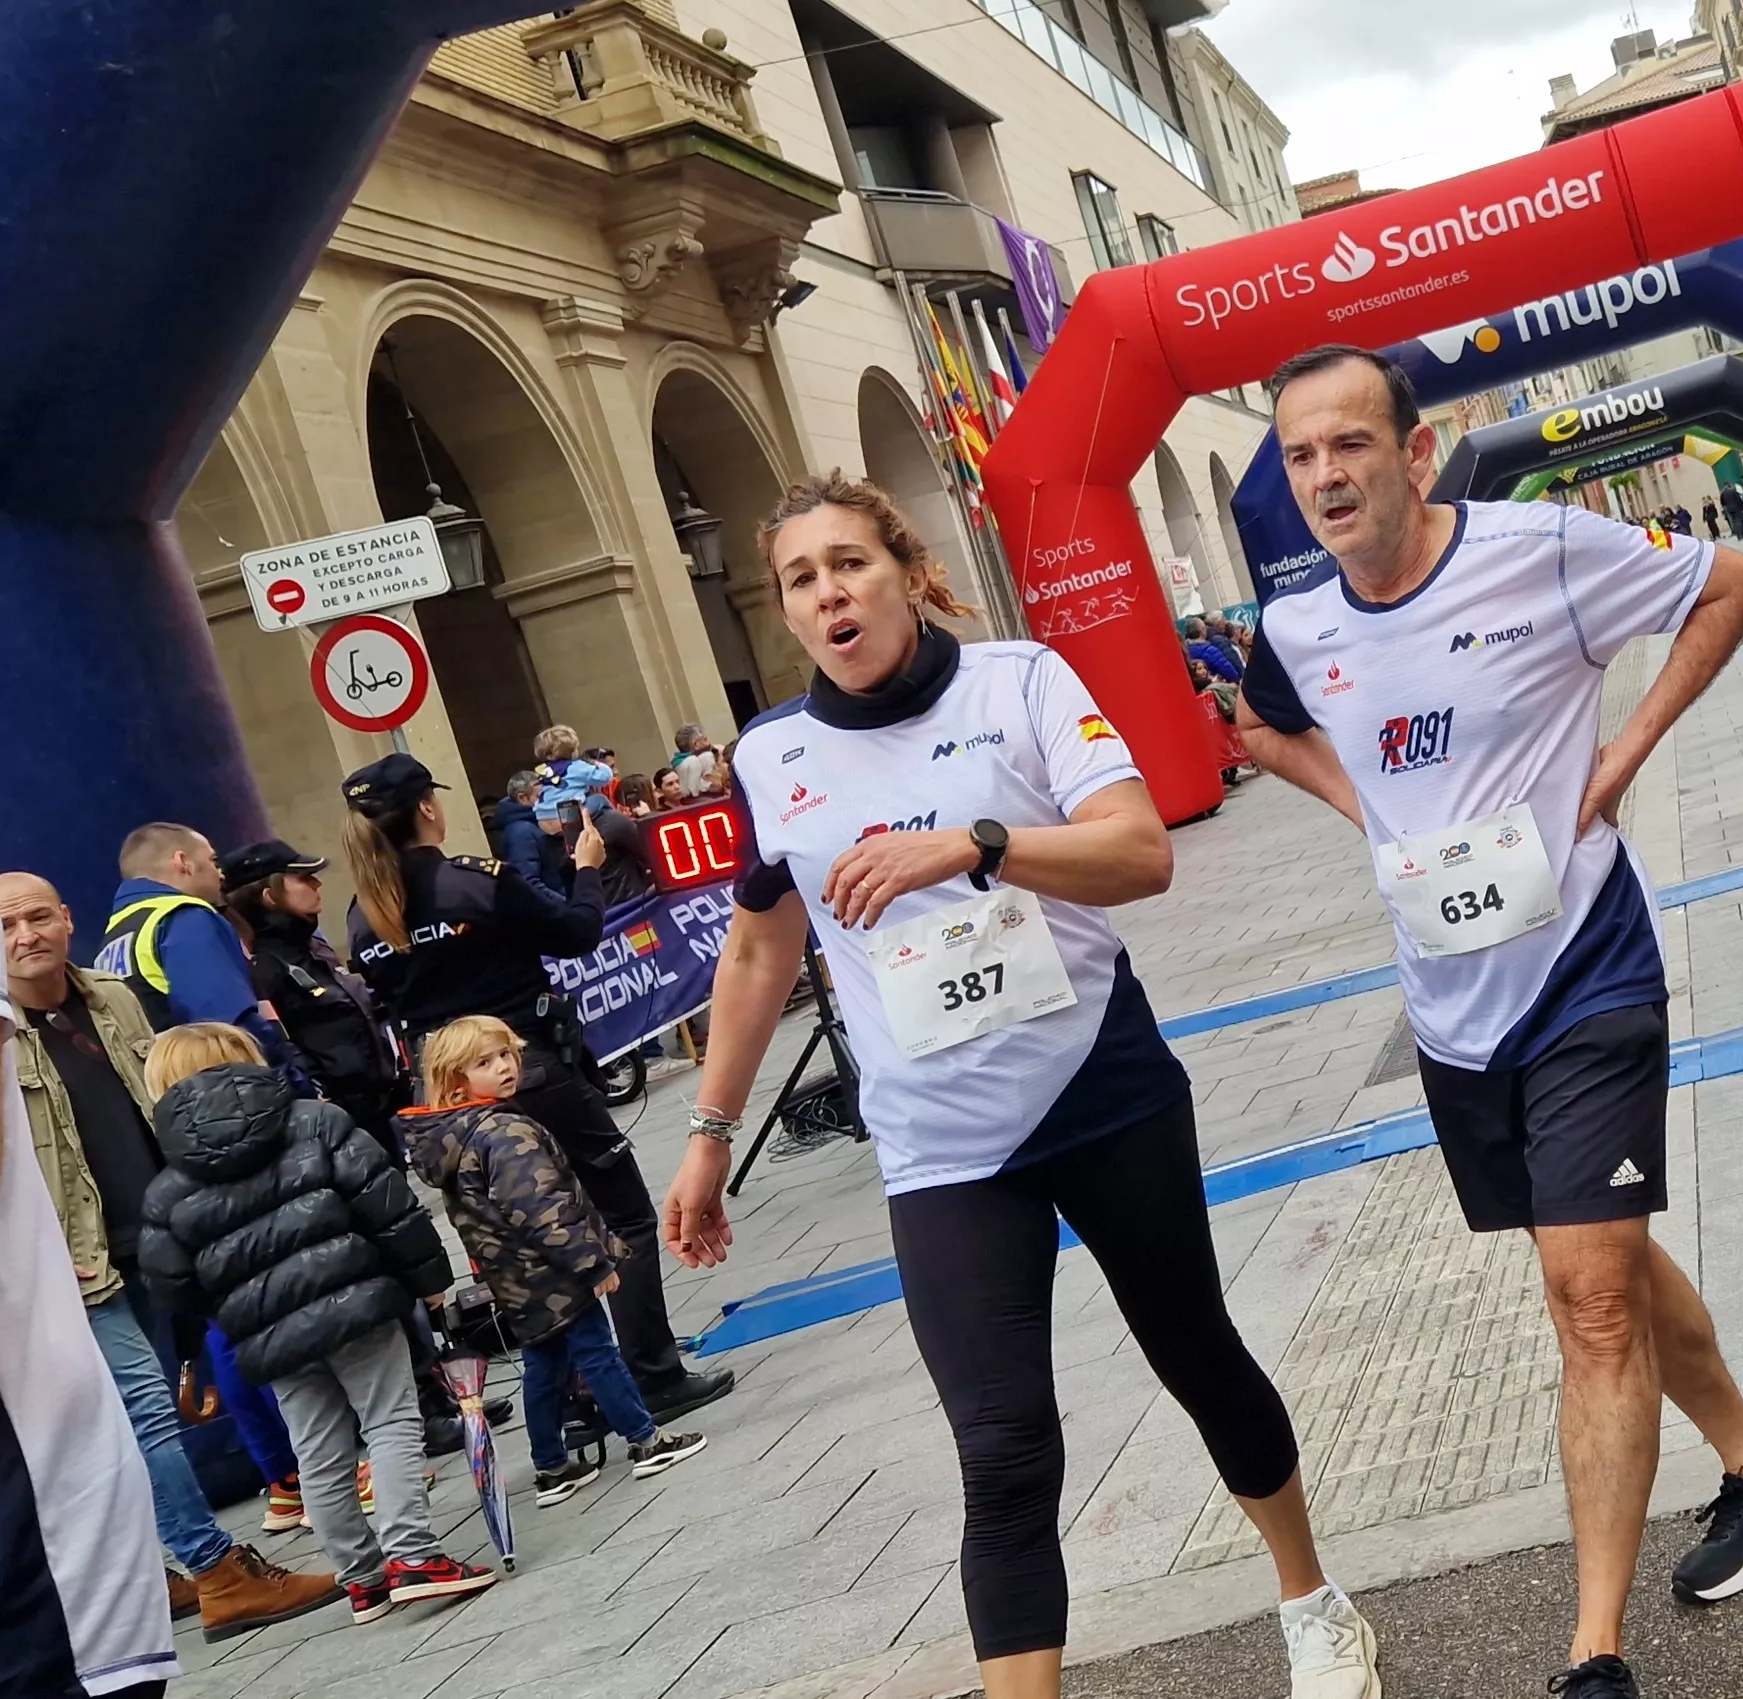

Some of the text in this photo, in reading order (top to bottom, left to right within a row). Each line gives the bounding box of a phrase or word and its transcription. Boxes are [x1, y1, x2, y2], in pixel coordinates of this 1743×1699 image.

[1176, 169, 1604, 331] Sports Santander
[1327, 268, 1470, 324] sportssantander.es
[1513, 258, 1682, 343] mupol
[1541, 386, 1666, 443] embou
[1627, 456, 1638, 466] DE
[257, 530, 421, 575] ZONA DE ESTANCIA
[313, 546, 425, 578] EXCEPTO CARGA
[1033, 537, 1096, 570] Sports
[1260, 548, 1328, 579] fundación
[317, 566, 403, 592] Y DESCARGA
[321, 576, 430, 609] DE 9 A 11 HORAS
[1039, 560, 1132, 601] Santander
[1485, 620, 1534, 645] mupol
[779, 793, 828, 825] Santander
[1440, 883, 1505, 925] 634
[360, 921, 456, 965] POICIA
[888, 951, 928, 971] Santander
[937, 962, 1005, 1012] 387
[1609, 1172, 1645, 1187] adidas
